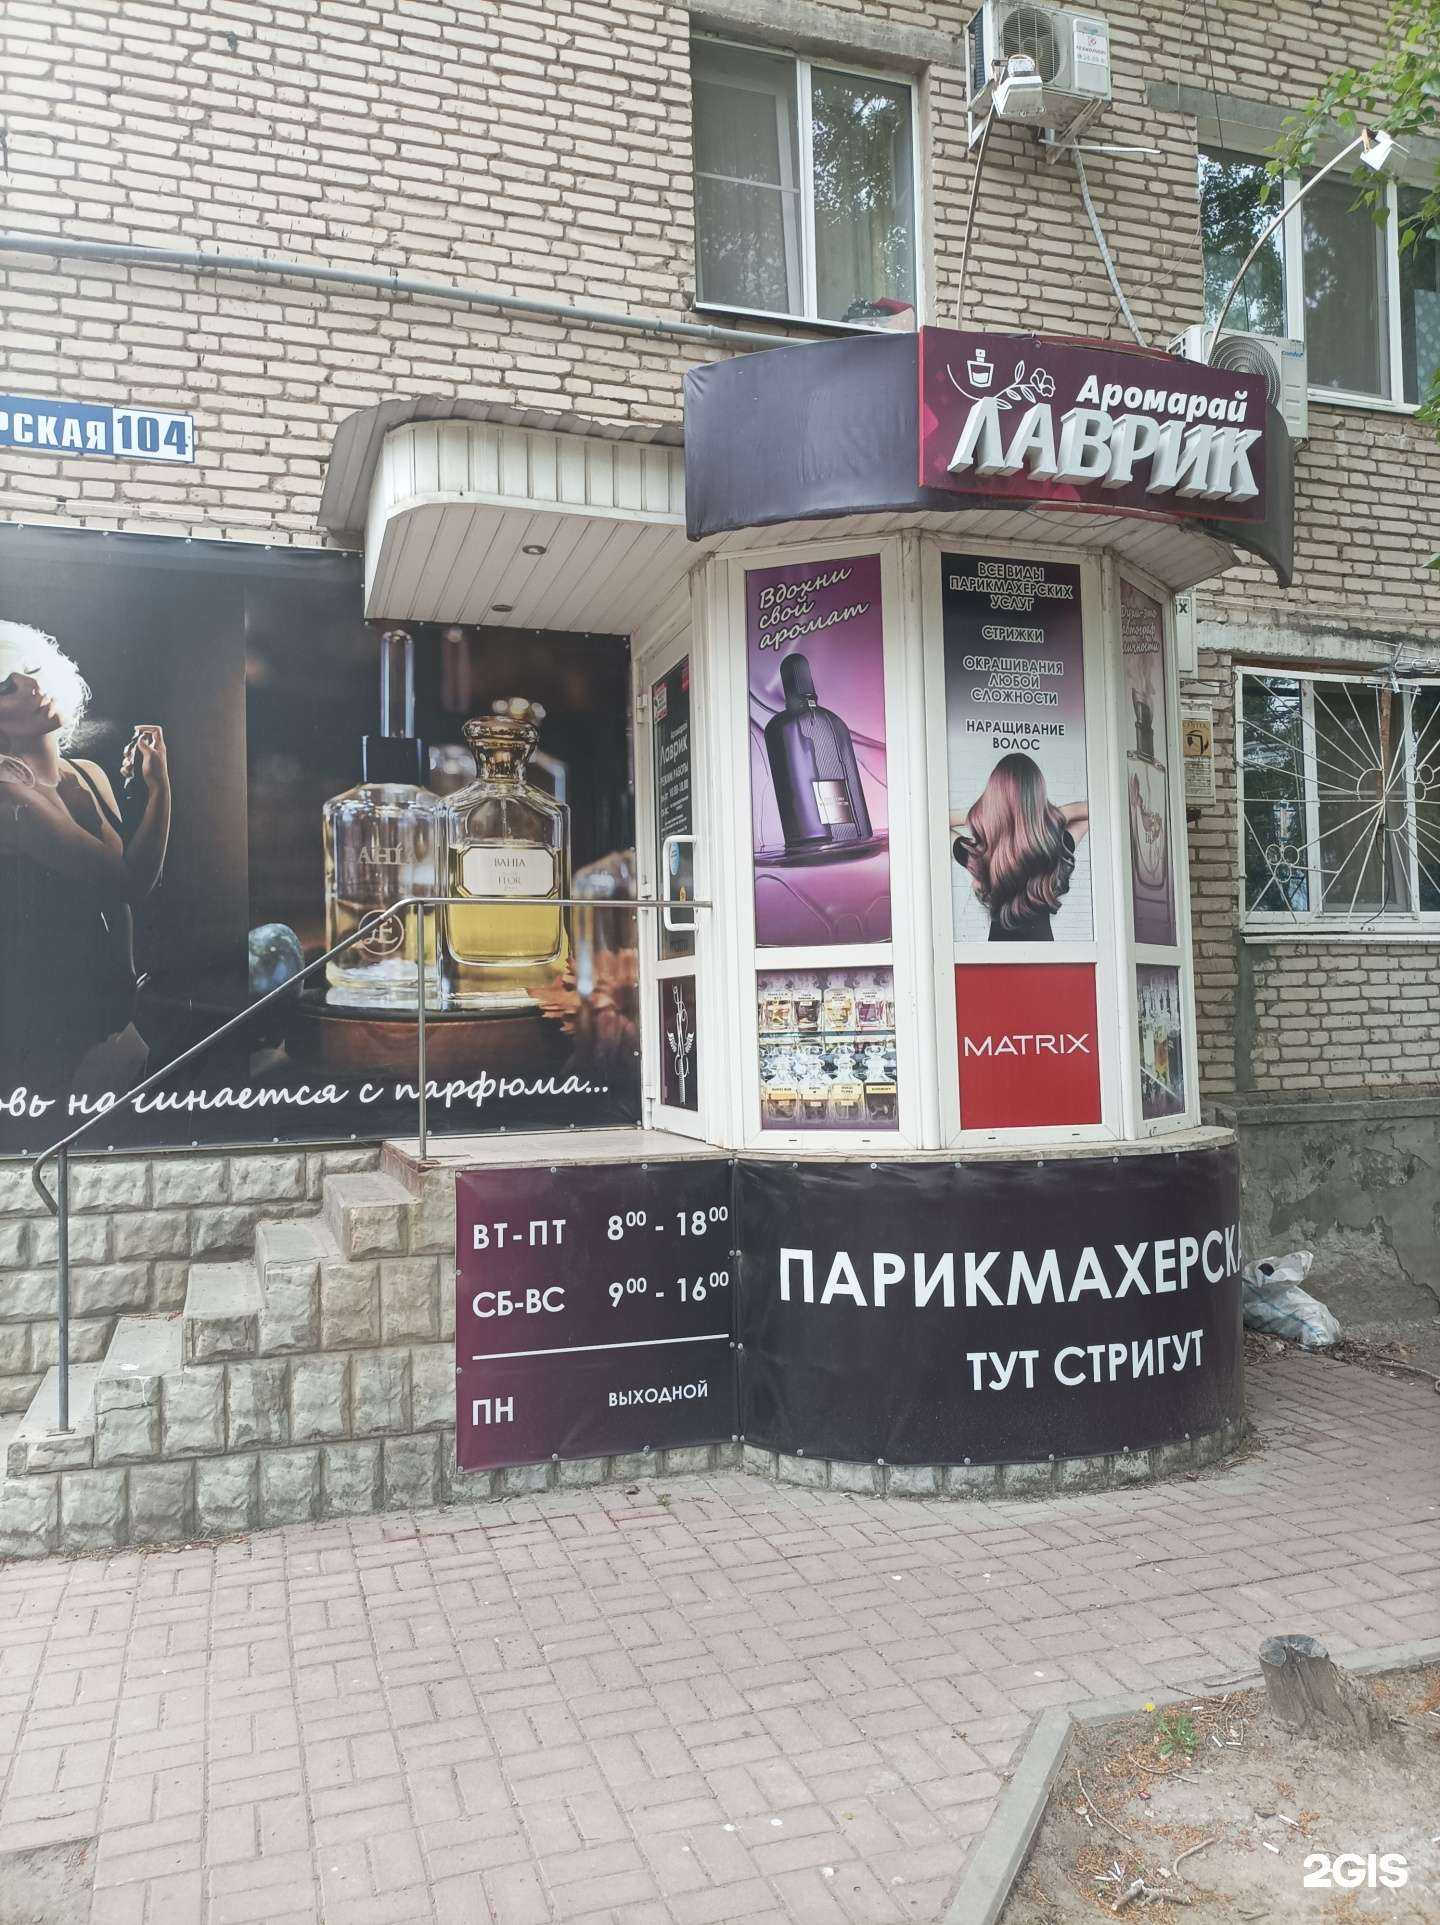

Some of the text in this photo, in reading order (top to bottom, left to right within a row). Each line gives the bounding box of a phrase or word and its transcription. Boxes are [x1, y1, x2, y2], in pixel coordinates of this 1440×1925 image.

[1075, 375, 1249, 423] Аромарай
[117, 414, 188, 455] 104
[947, 397, 1263, 502] ЛАВРИК
[950, 575, 1073, 599] ПАРИКМАХЕРСКИХ
[977, 562, 1044, 581] ВСЕ ВИДЫ
[759, 568, 852, 609] Вдохни
[990, 594, 1035, 611] УСЛУГ
[759, 595, 815, 629] свой
[759, 602, 869, 650] аромат
[982, 625, 1044, 643] СТРИЖКИ
[963, 655, 1064, 676] ОКРАШИВАНИЯ
[988, 672, 1040, 689] ЛЮБОЙ
[971, 688, 1059, 706] СЛОЖНОСТИ
[966, 720, 1065, 736] НАРАЩИВАНИЕ
[993, 737, 1040, 751] ВОЛОС
[963, 1033, 1090, 1057] MATRIX
[359, 1083, 384, 1103] с
[395, 1070, 609, 1108] парфюма...
[473, 1219, 566, 1250] ВТ-ПТ
[472, 1286, 565, 1318] СБ-ВС
[966, 1328, 1204, 1391] ТУТ СТРИГУТ
[472, 1379, 708, 1426] ПН ВЫХОДНОЙ
